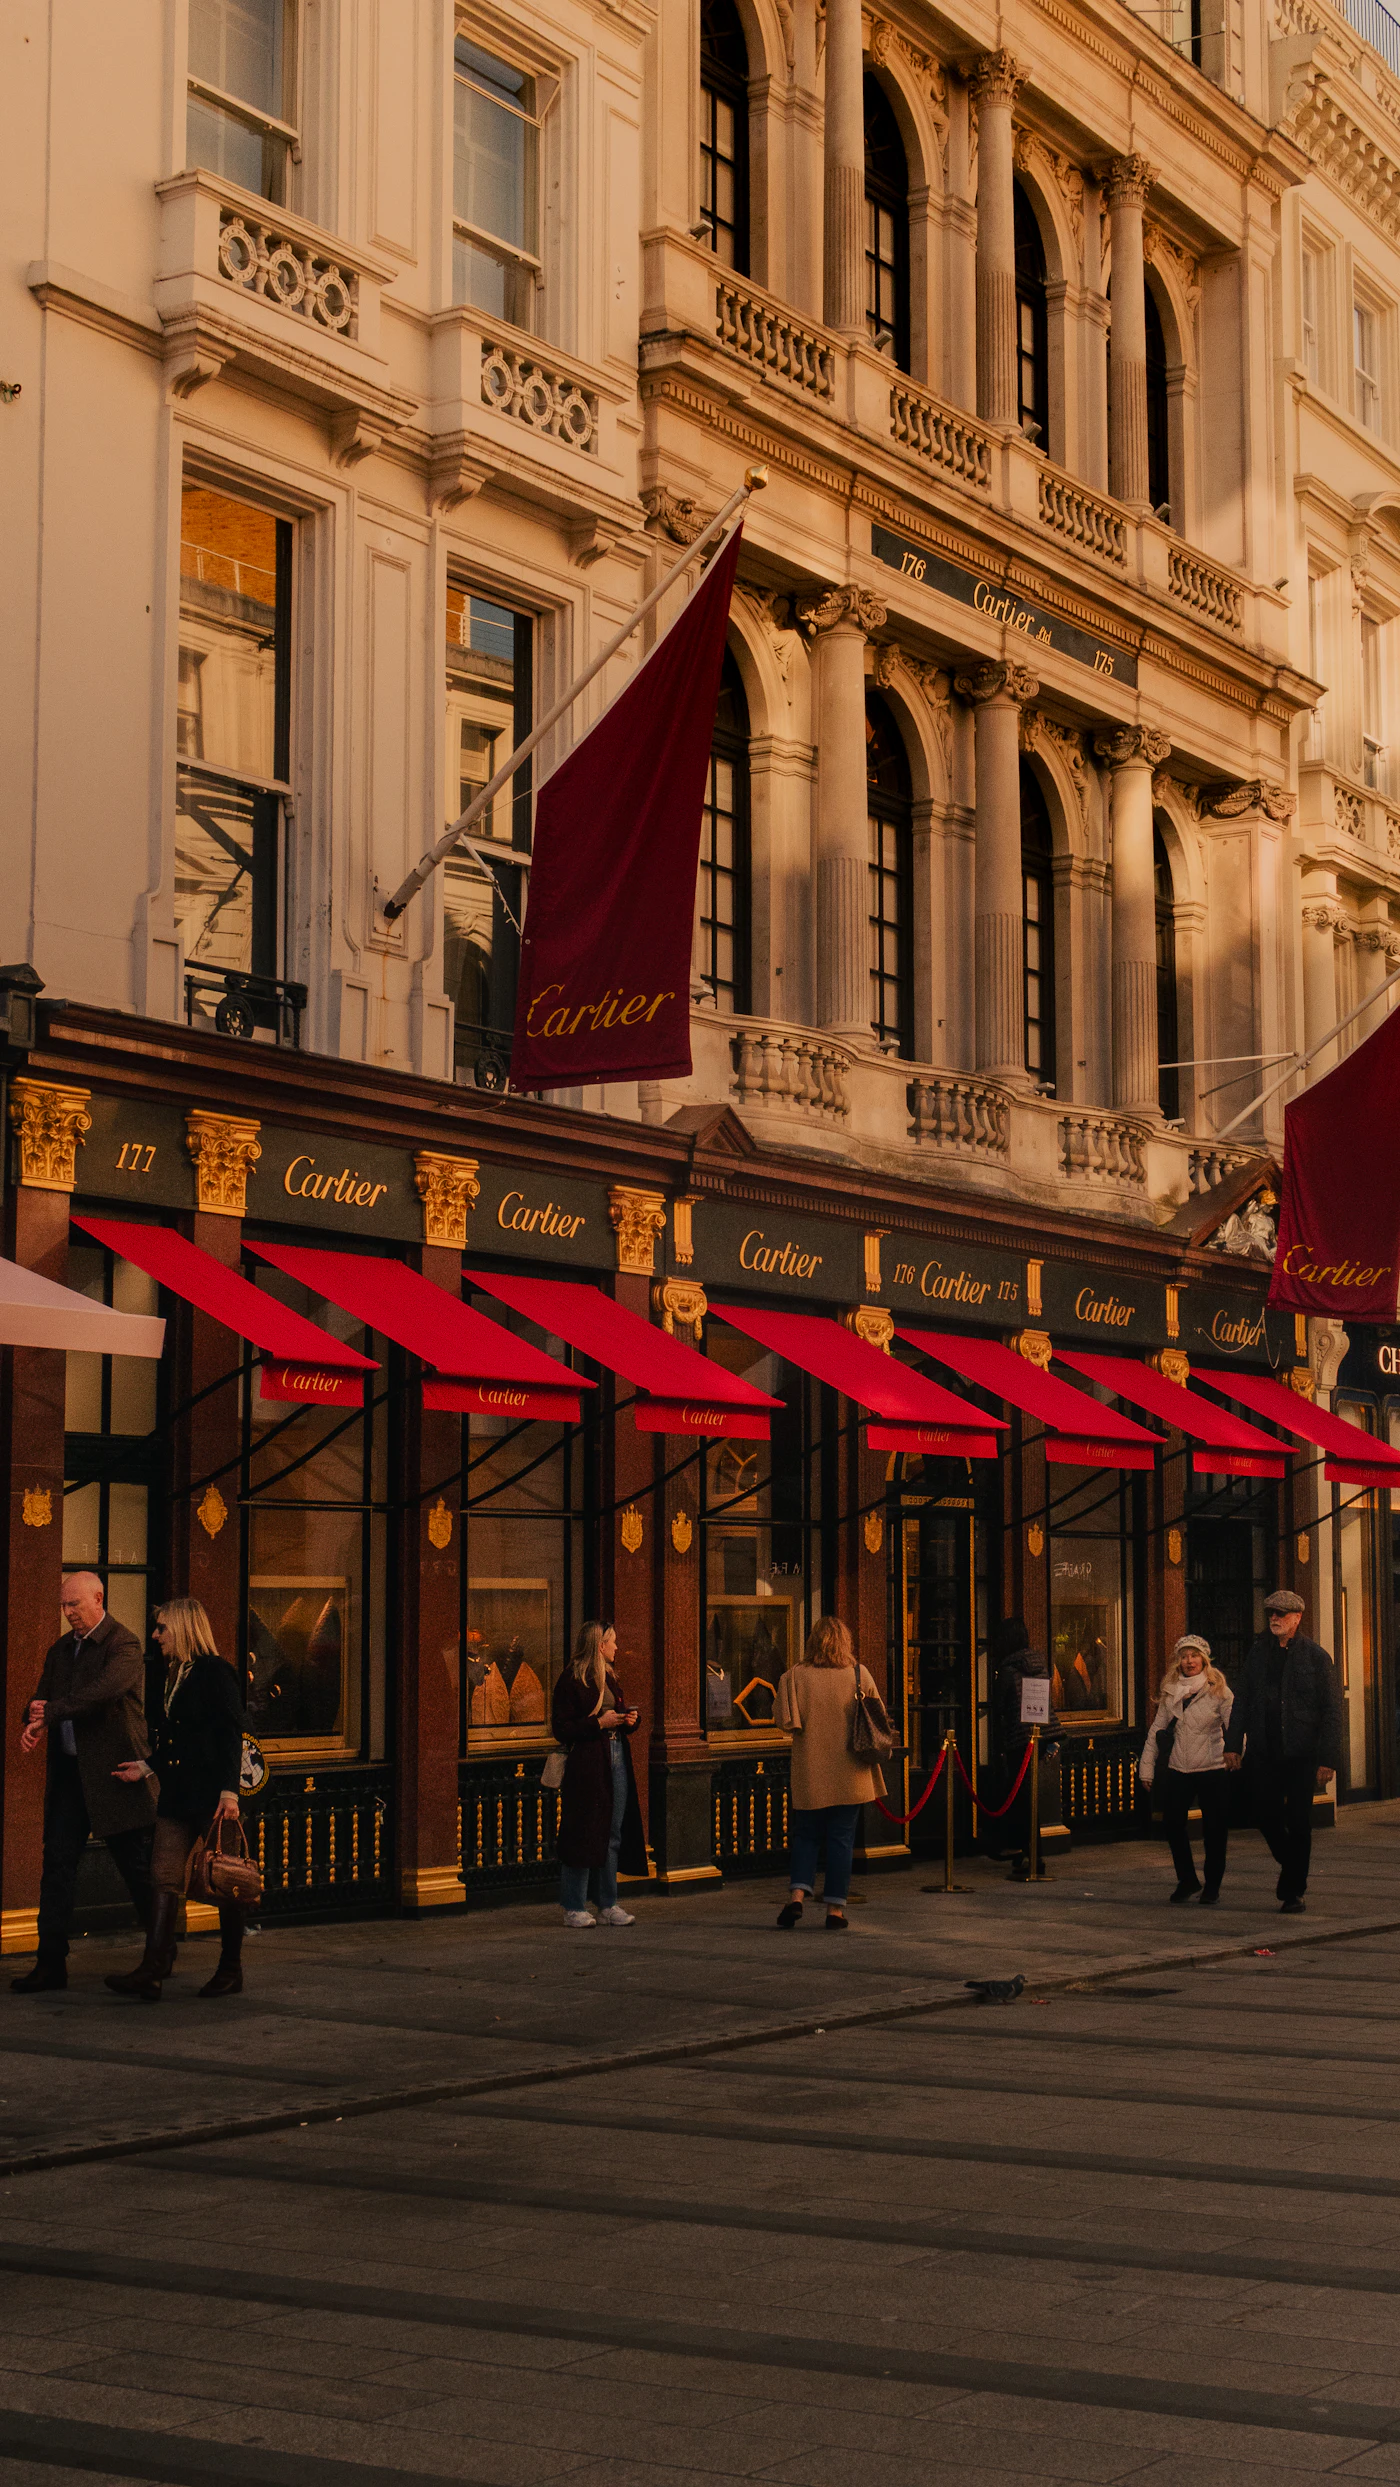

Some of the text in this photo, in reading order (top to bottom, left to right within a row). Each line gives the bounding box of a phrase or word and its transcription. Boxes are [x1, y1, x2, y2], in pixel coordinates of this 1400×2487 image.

[900, 551, 1115, 676] 176 Cartier Ltd 175
[526, 984, 676, 1038] Cartier
[115, 1142, 156, 1173] 177
[284, 1155, 388, 1208] Cartier
[498, 1191, 586, 1239] Cartier
[739, 1230, 823, 1279] Cartier
[1281, 1243, 1392, 1287] Cartier
[892, 1260, 1019, 1305] 176 Cartier 175
[1074, 1287, 1136, 1327] Cartier
[1211, 1309, 1265, 1346] Cartier
[281, 1365, 343, 1393] Cartier
[478, 1381, 530, 1406] Cartier
[682, 1404, 727, 1426] Cartier
